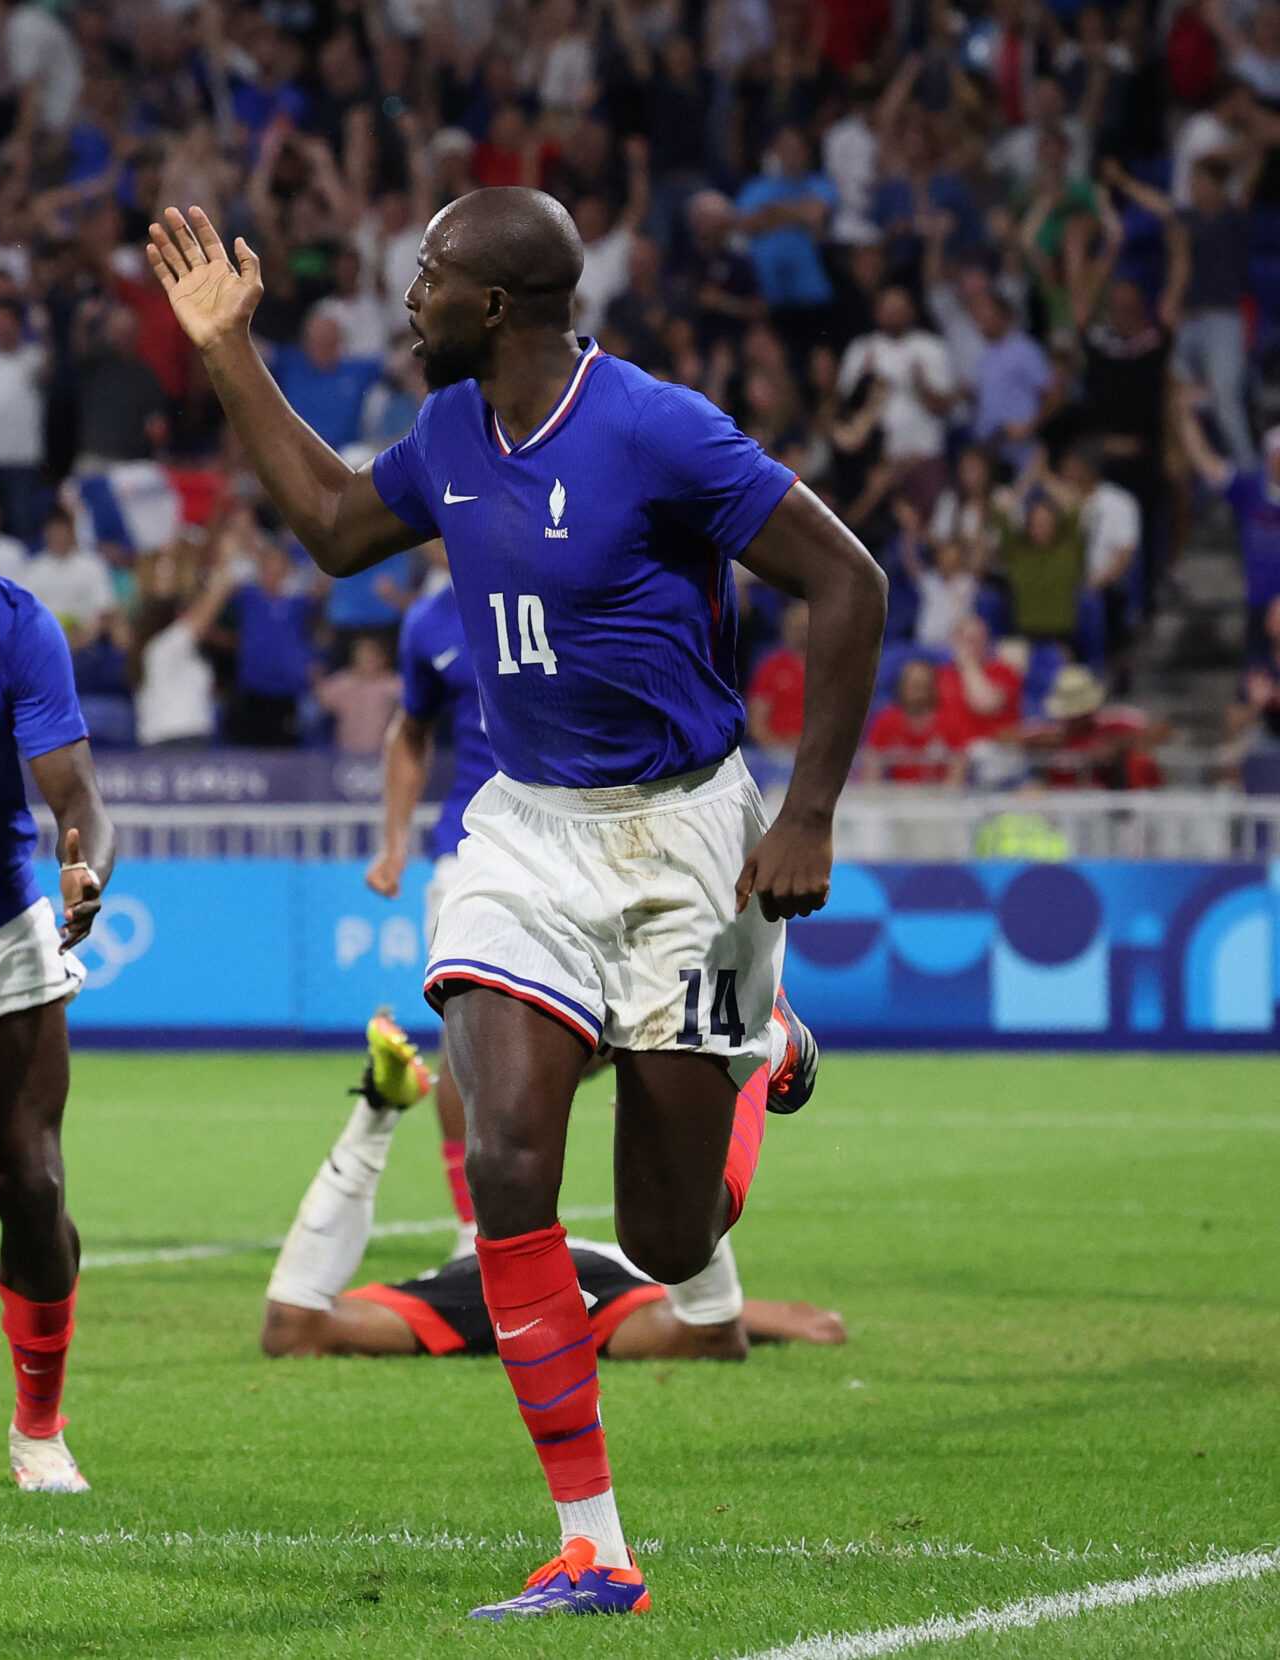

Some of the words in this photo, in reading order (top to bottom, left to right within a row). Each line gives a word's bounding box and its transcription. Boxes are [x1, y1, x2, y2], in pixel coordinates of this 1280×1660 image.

[545, 527, 568, 539] FRANCE
[489, 593, 558, 675] 14
[676, 969, 745, 1047] 14
